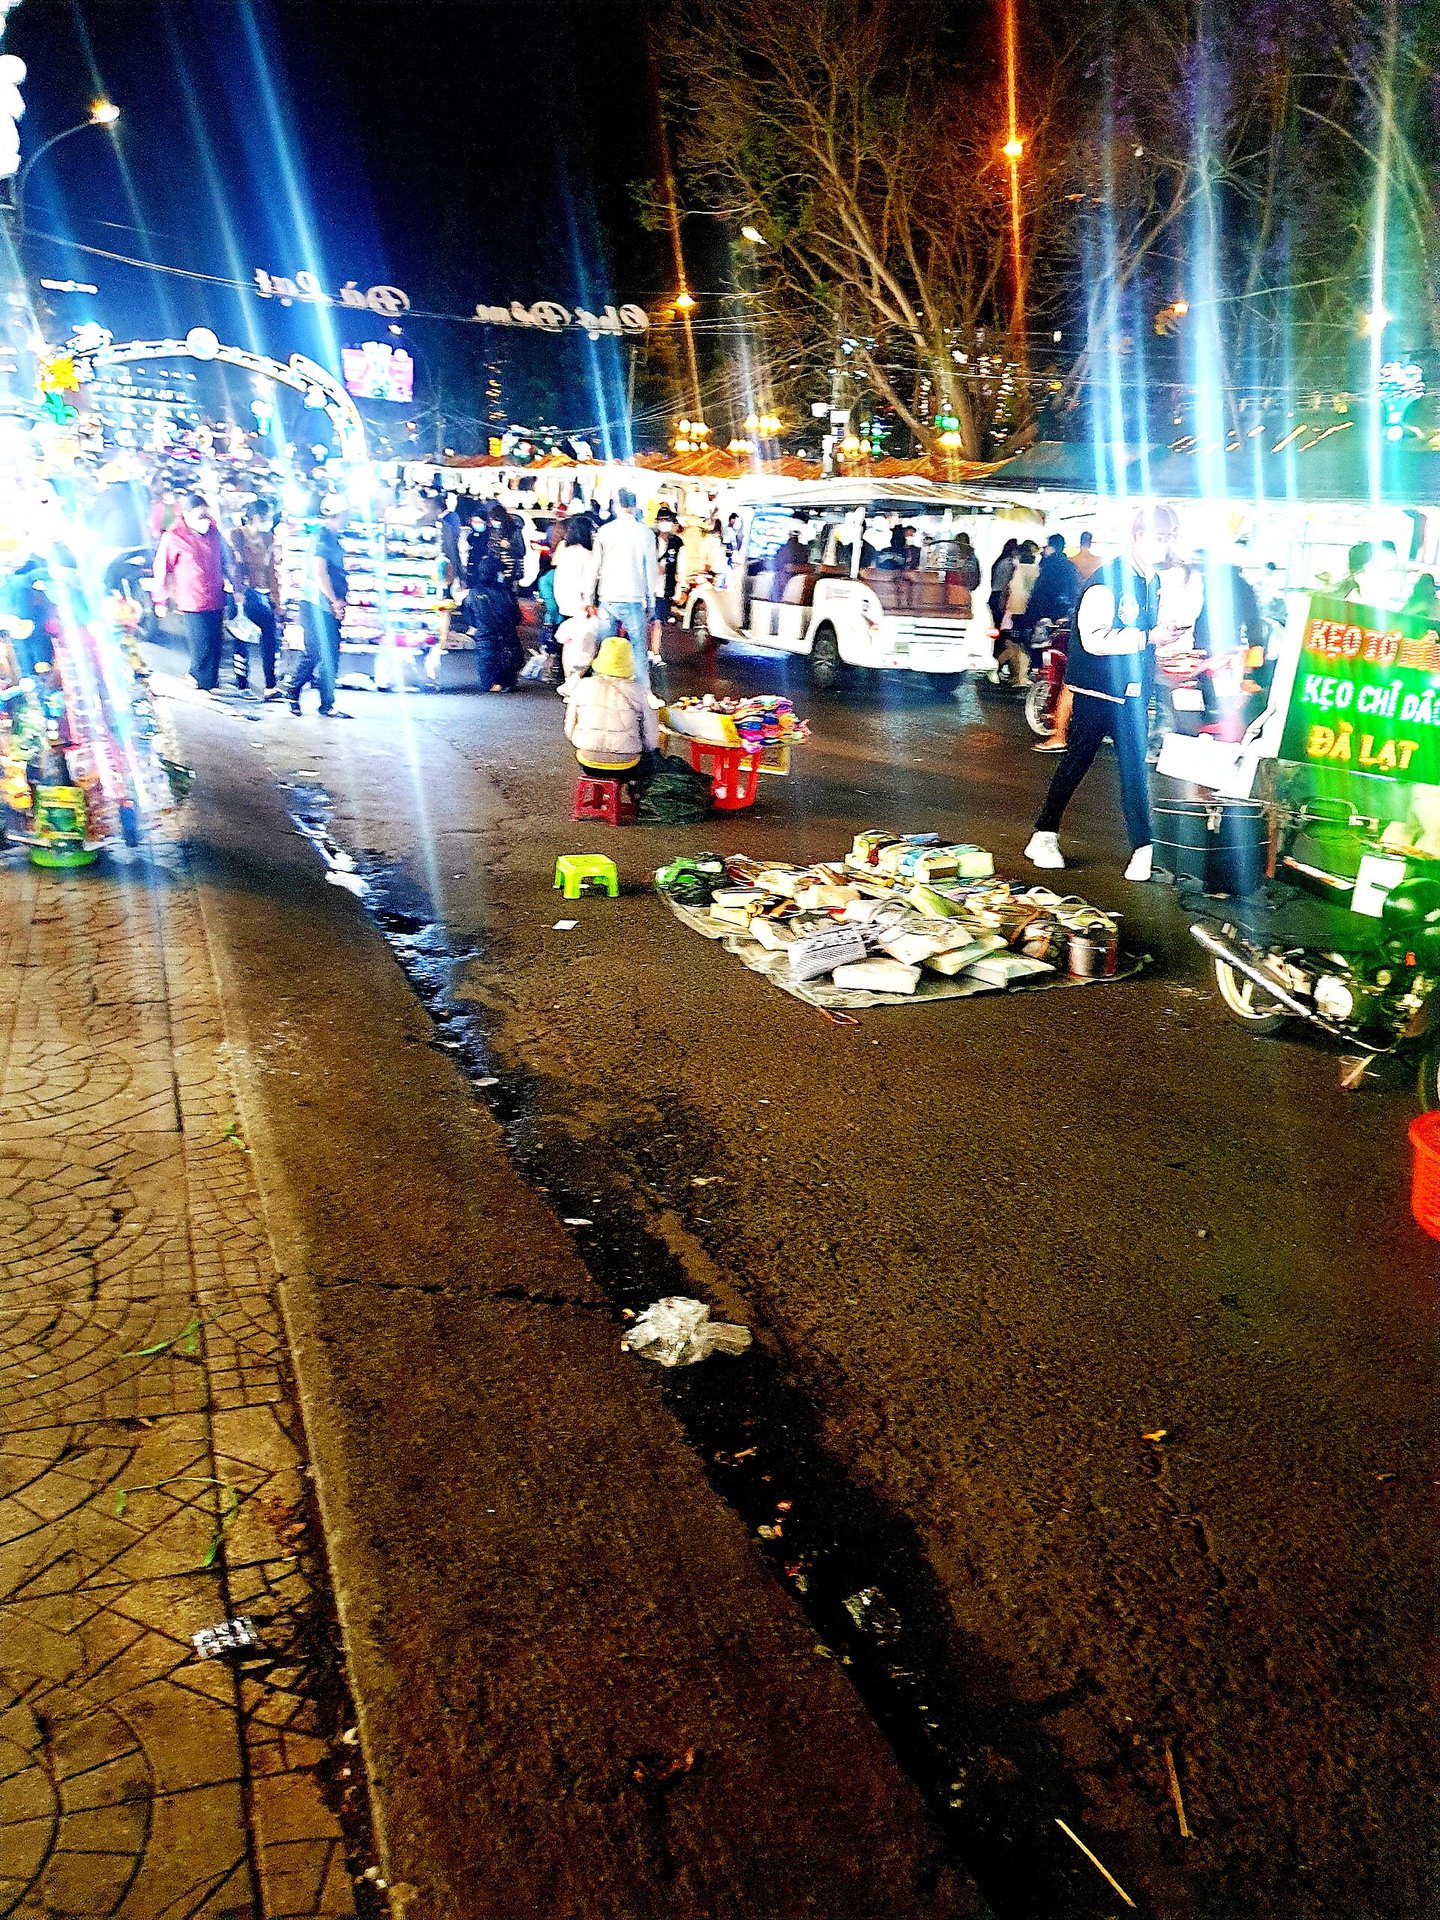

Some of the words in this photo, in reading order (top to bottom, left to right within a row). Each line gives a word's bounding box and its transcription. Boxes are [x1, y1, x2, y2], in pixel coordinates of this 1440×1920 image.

[1307, 619, 1362, 661] KẸO
[1302, 674, 1354, 711] KẸO
[1357, 680, 1403, 717] CHỈ
[1358, 734, 1419, 771] LẠT
